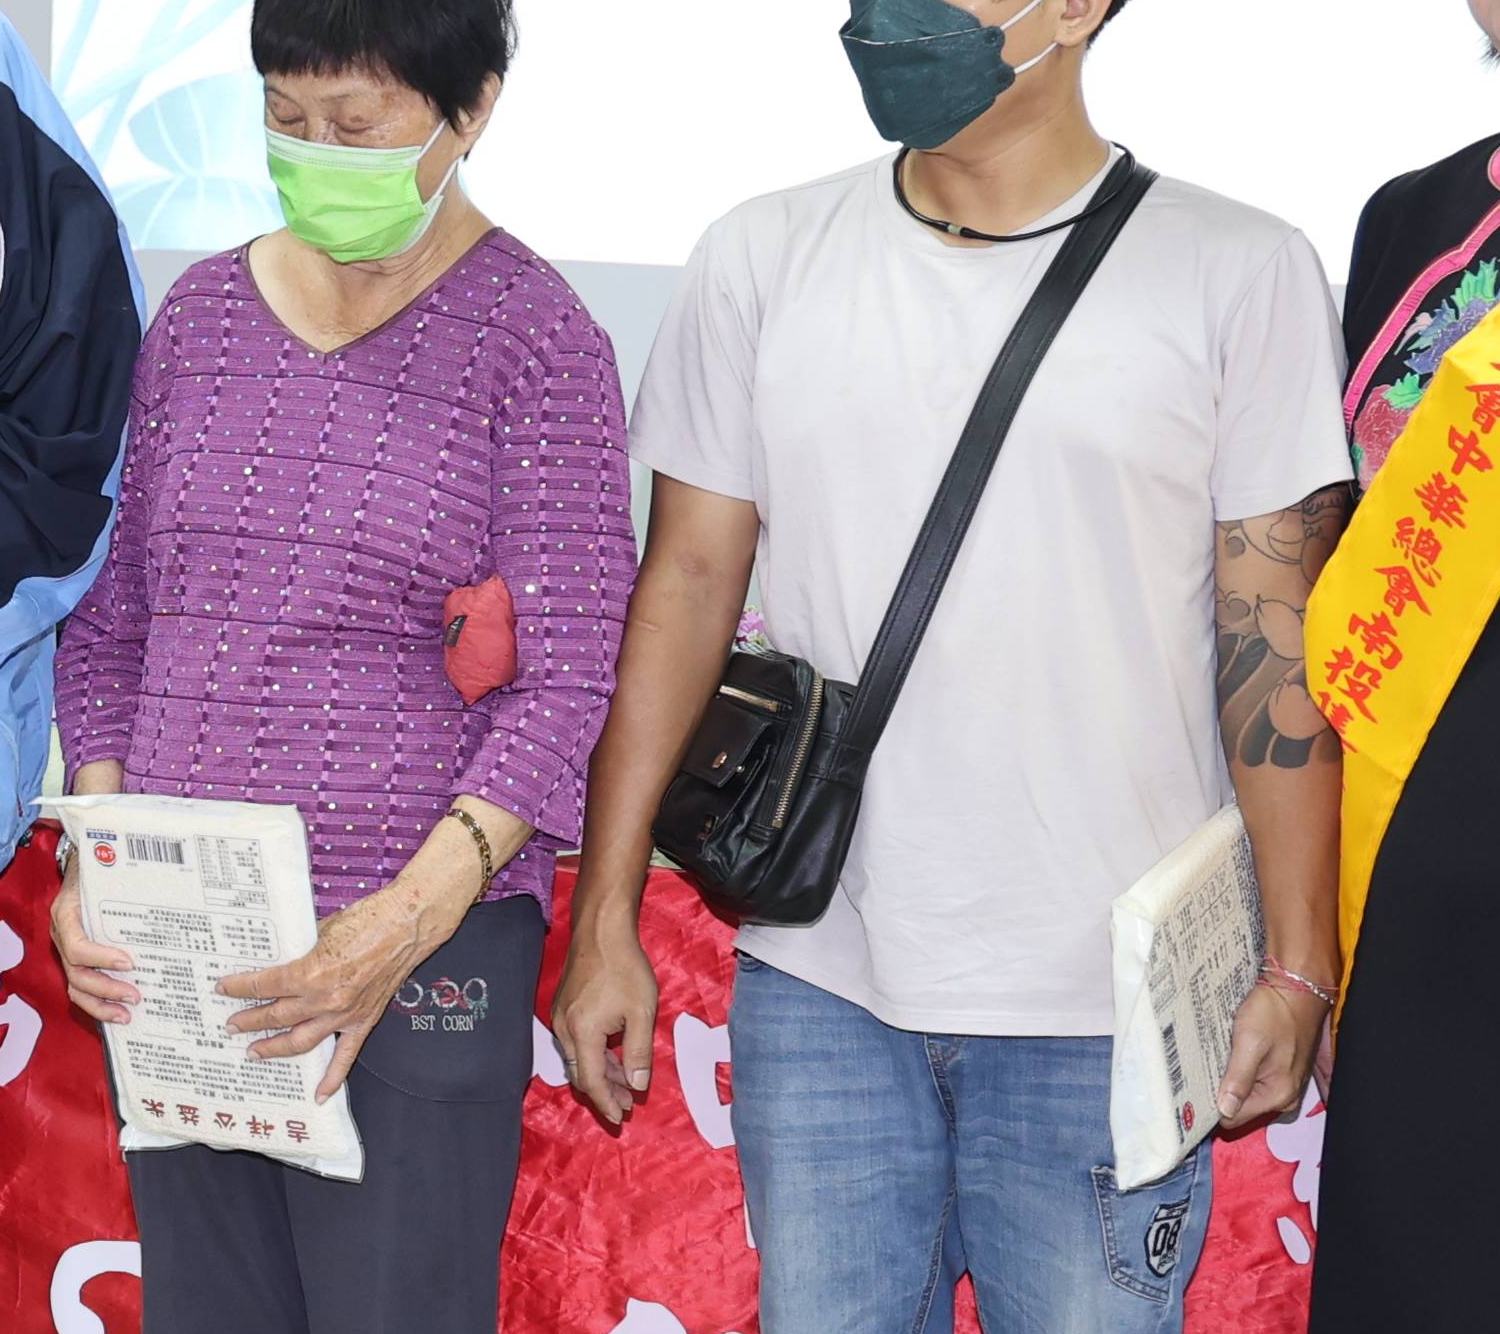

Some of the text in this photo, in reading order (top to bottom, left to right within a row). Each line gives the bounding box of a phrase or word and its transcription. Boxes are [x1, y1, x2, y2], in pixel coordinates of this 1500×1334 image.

[410, 1014, 474, 1031] BST CORN
[141, 1097, 312, 1144] 吉祥公益米
